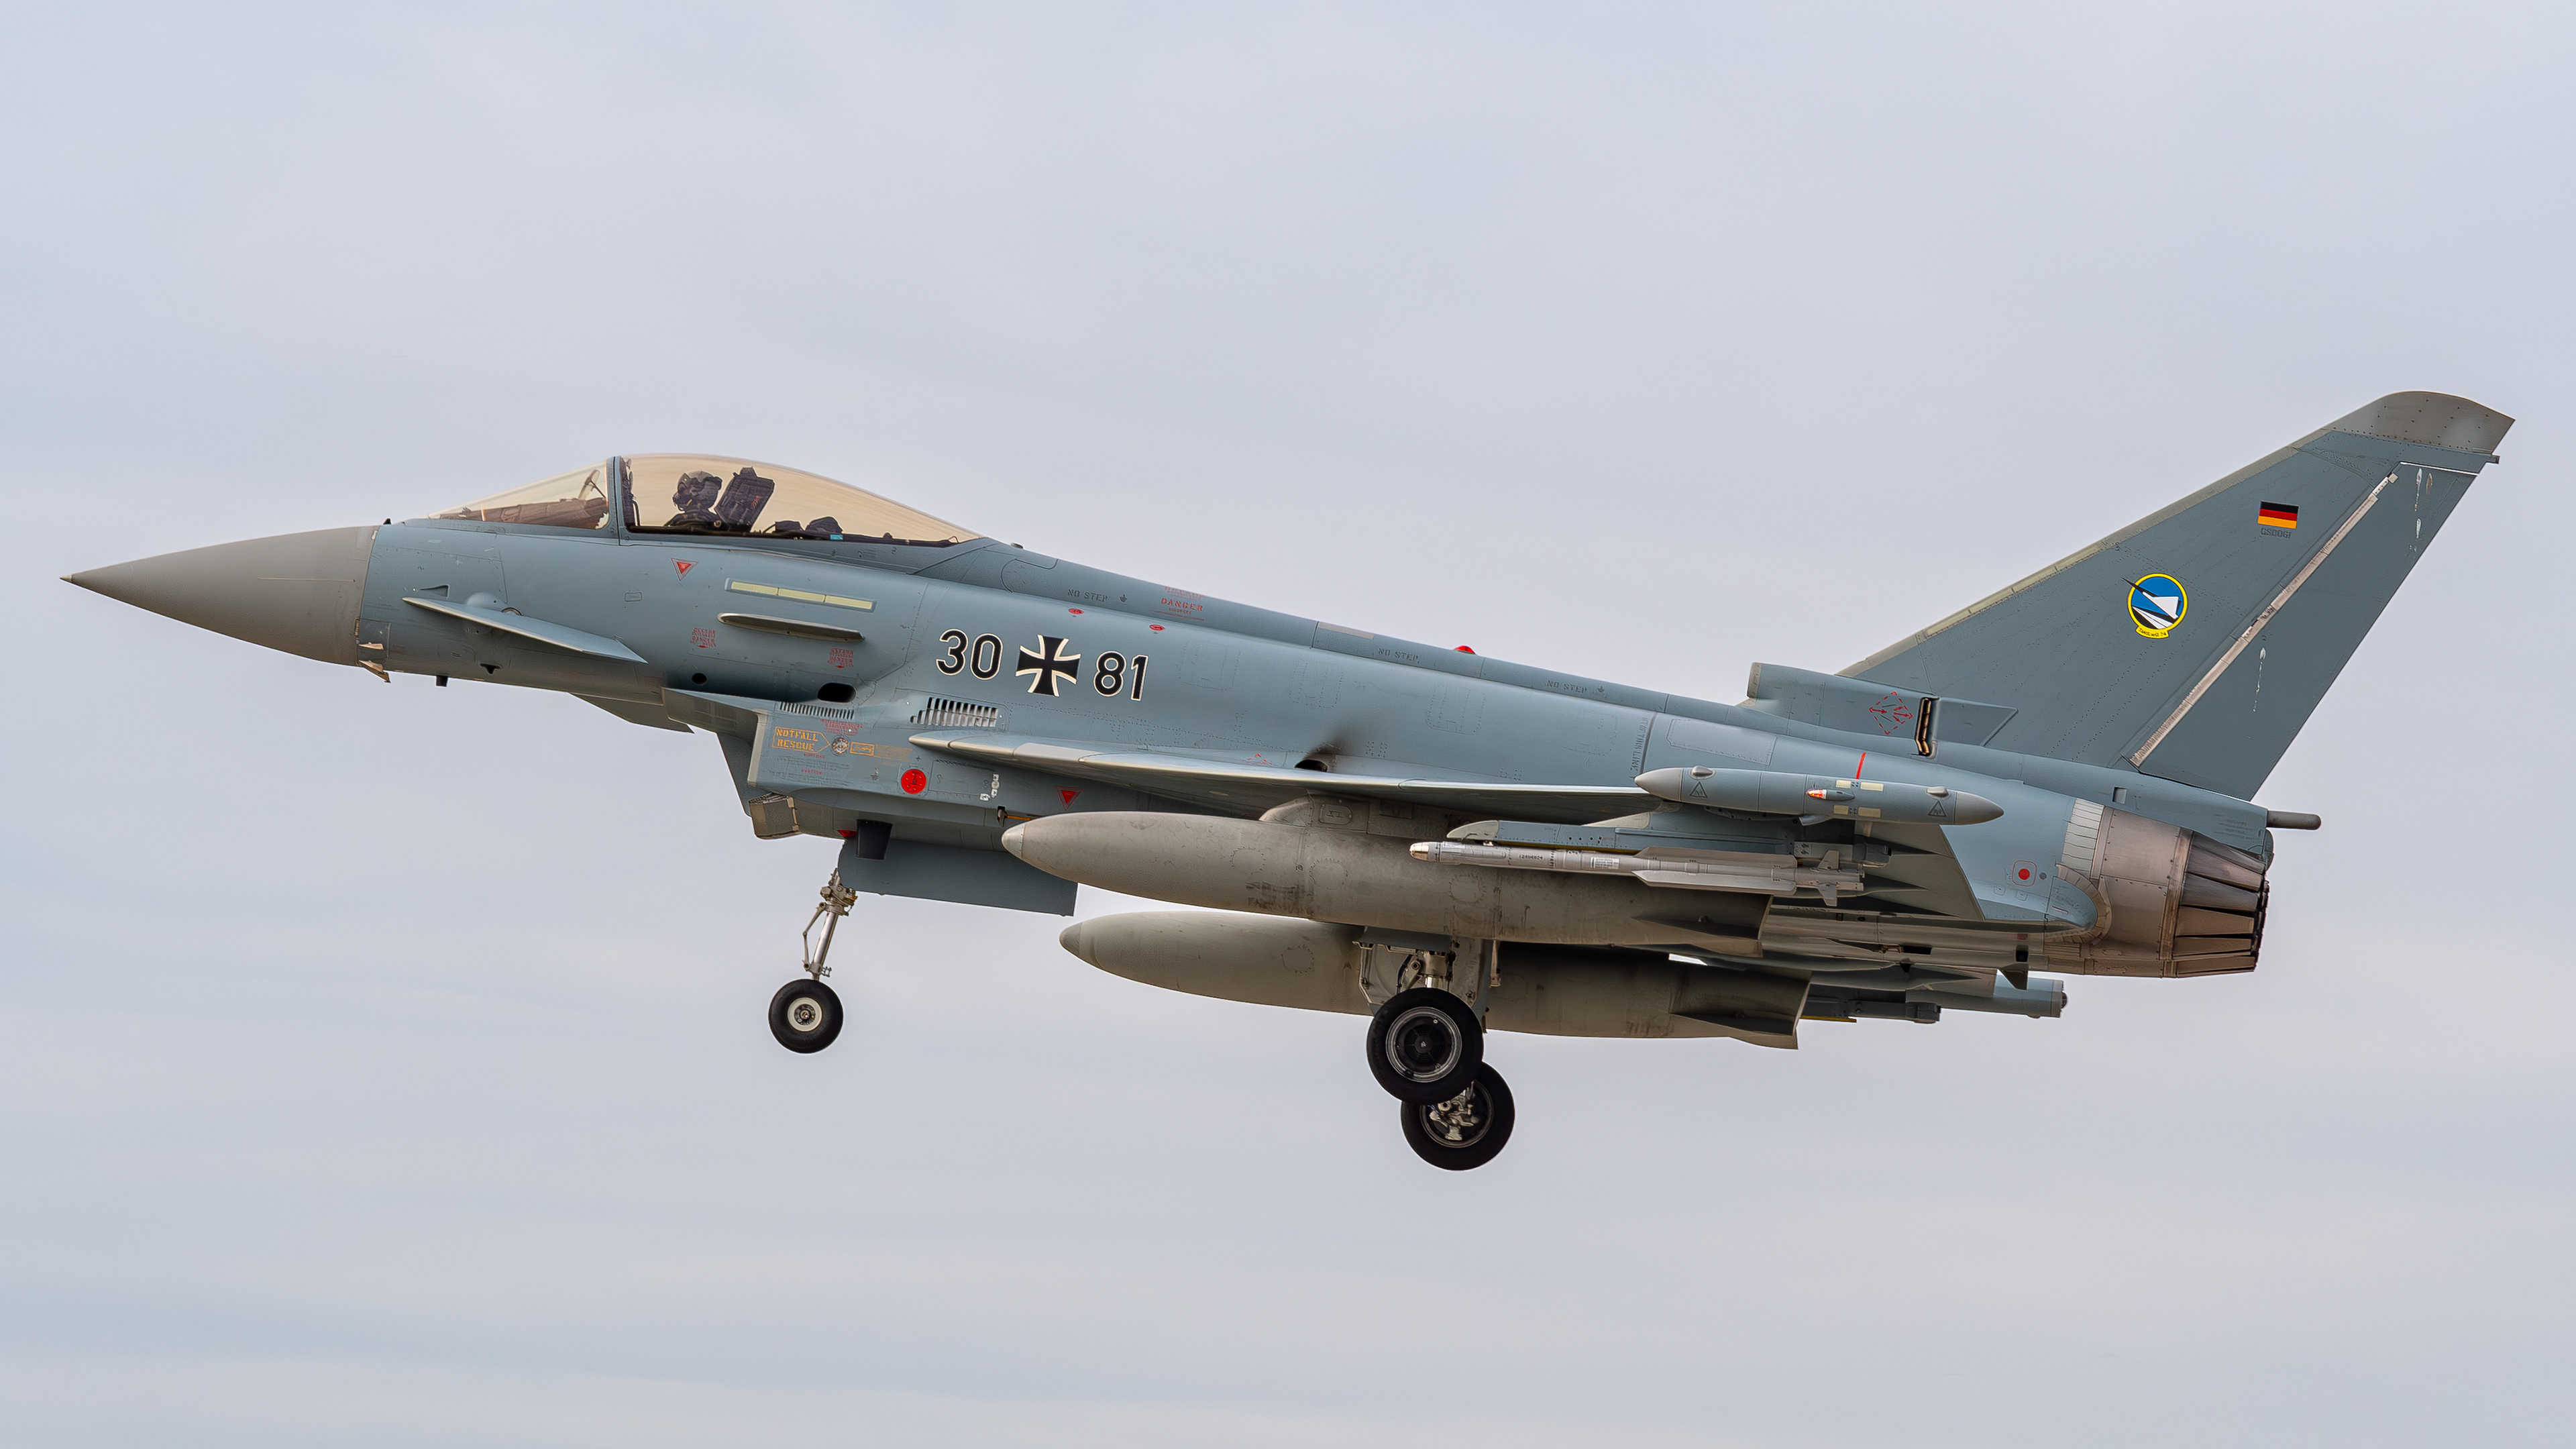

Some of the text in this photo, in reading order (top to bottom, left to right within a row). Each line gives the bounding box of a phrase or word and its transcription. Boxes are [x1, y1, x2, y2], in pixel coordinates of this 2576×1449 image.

[1067, 589, 1108, 602] NO STEP
[1161, 597, 1203, 611] DANGER
[936, 629, 1003, 680] 30
[1378, 648, 1391, 656] NO
[1093, 650, 1148, 701] 81
[1546, 680, 1560, 688] NO
[776, 729, 818, 741] NOTFALL
[777, 738, 815, 751] RESCUE
